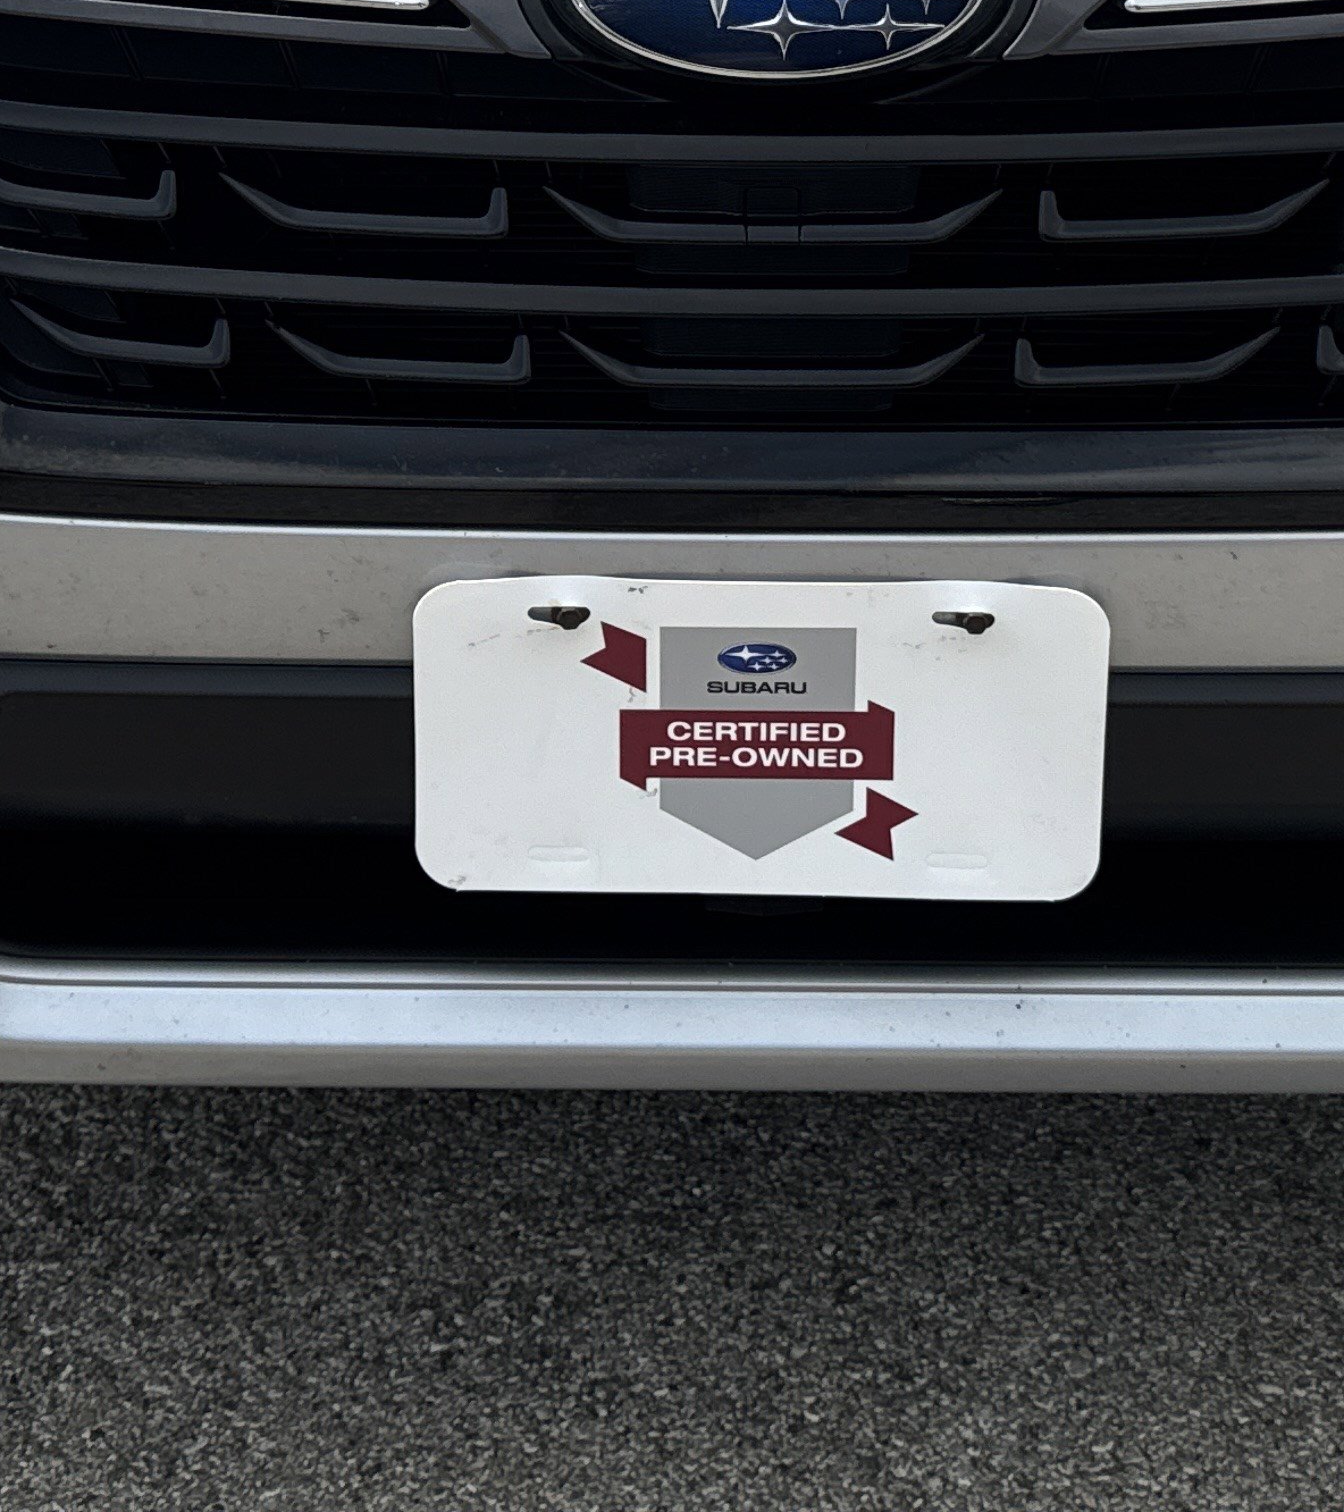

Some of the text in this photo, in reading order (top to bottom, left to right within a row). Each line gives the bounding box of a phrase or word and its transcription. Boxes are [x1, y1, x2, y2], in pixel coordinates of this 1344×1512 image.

[706, 681, 807, 695] SUBARU
[666, 721, 846, 742] CERTIFIED
[649, 746, 864, 768] PRE-OWNED
